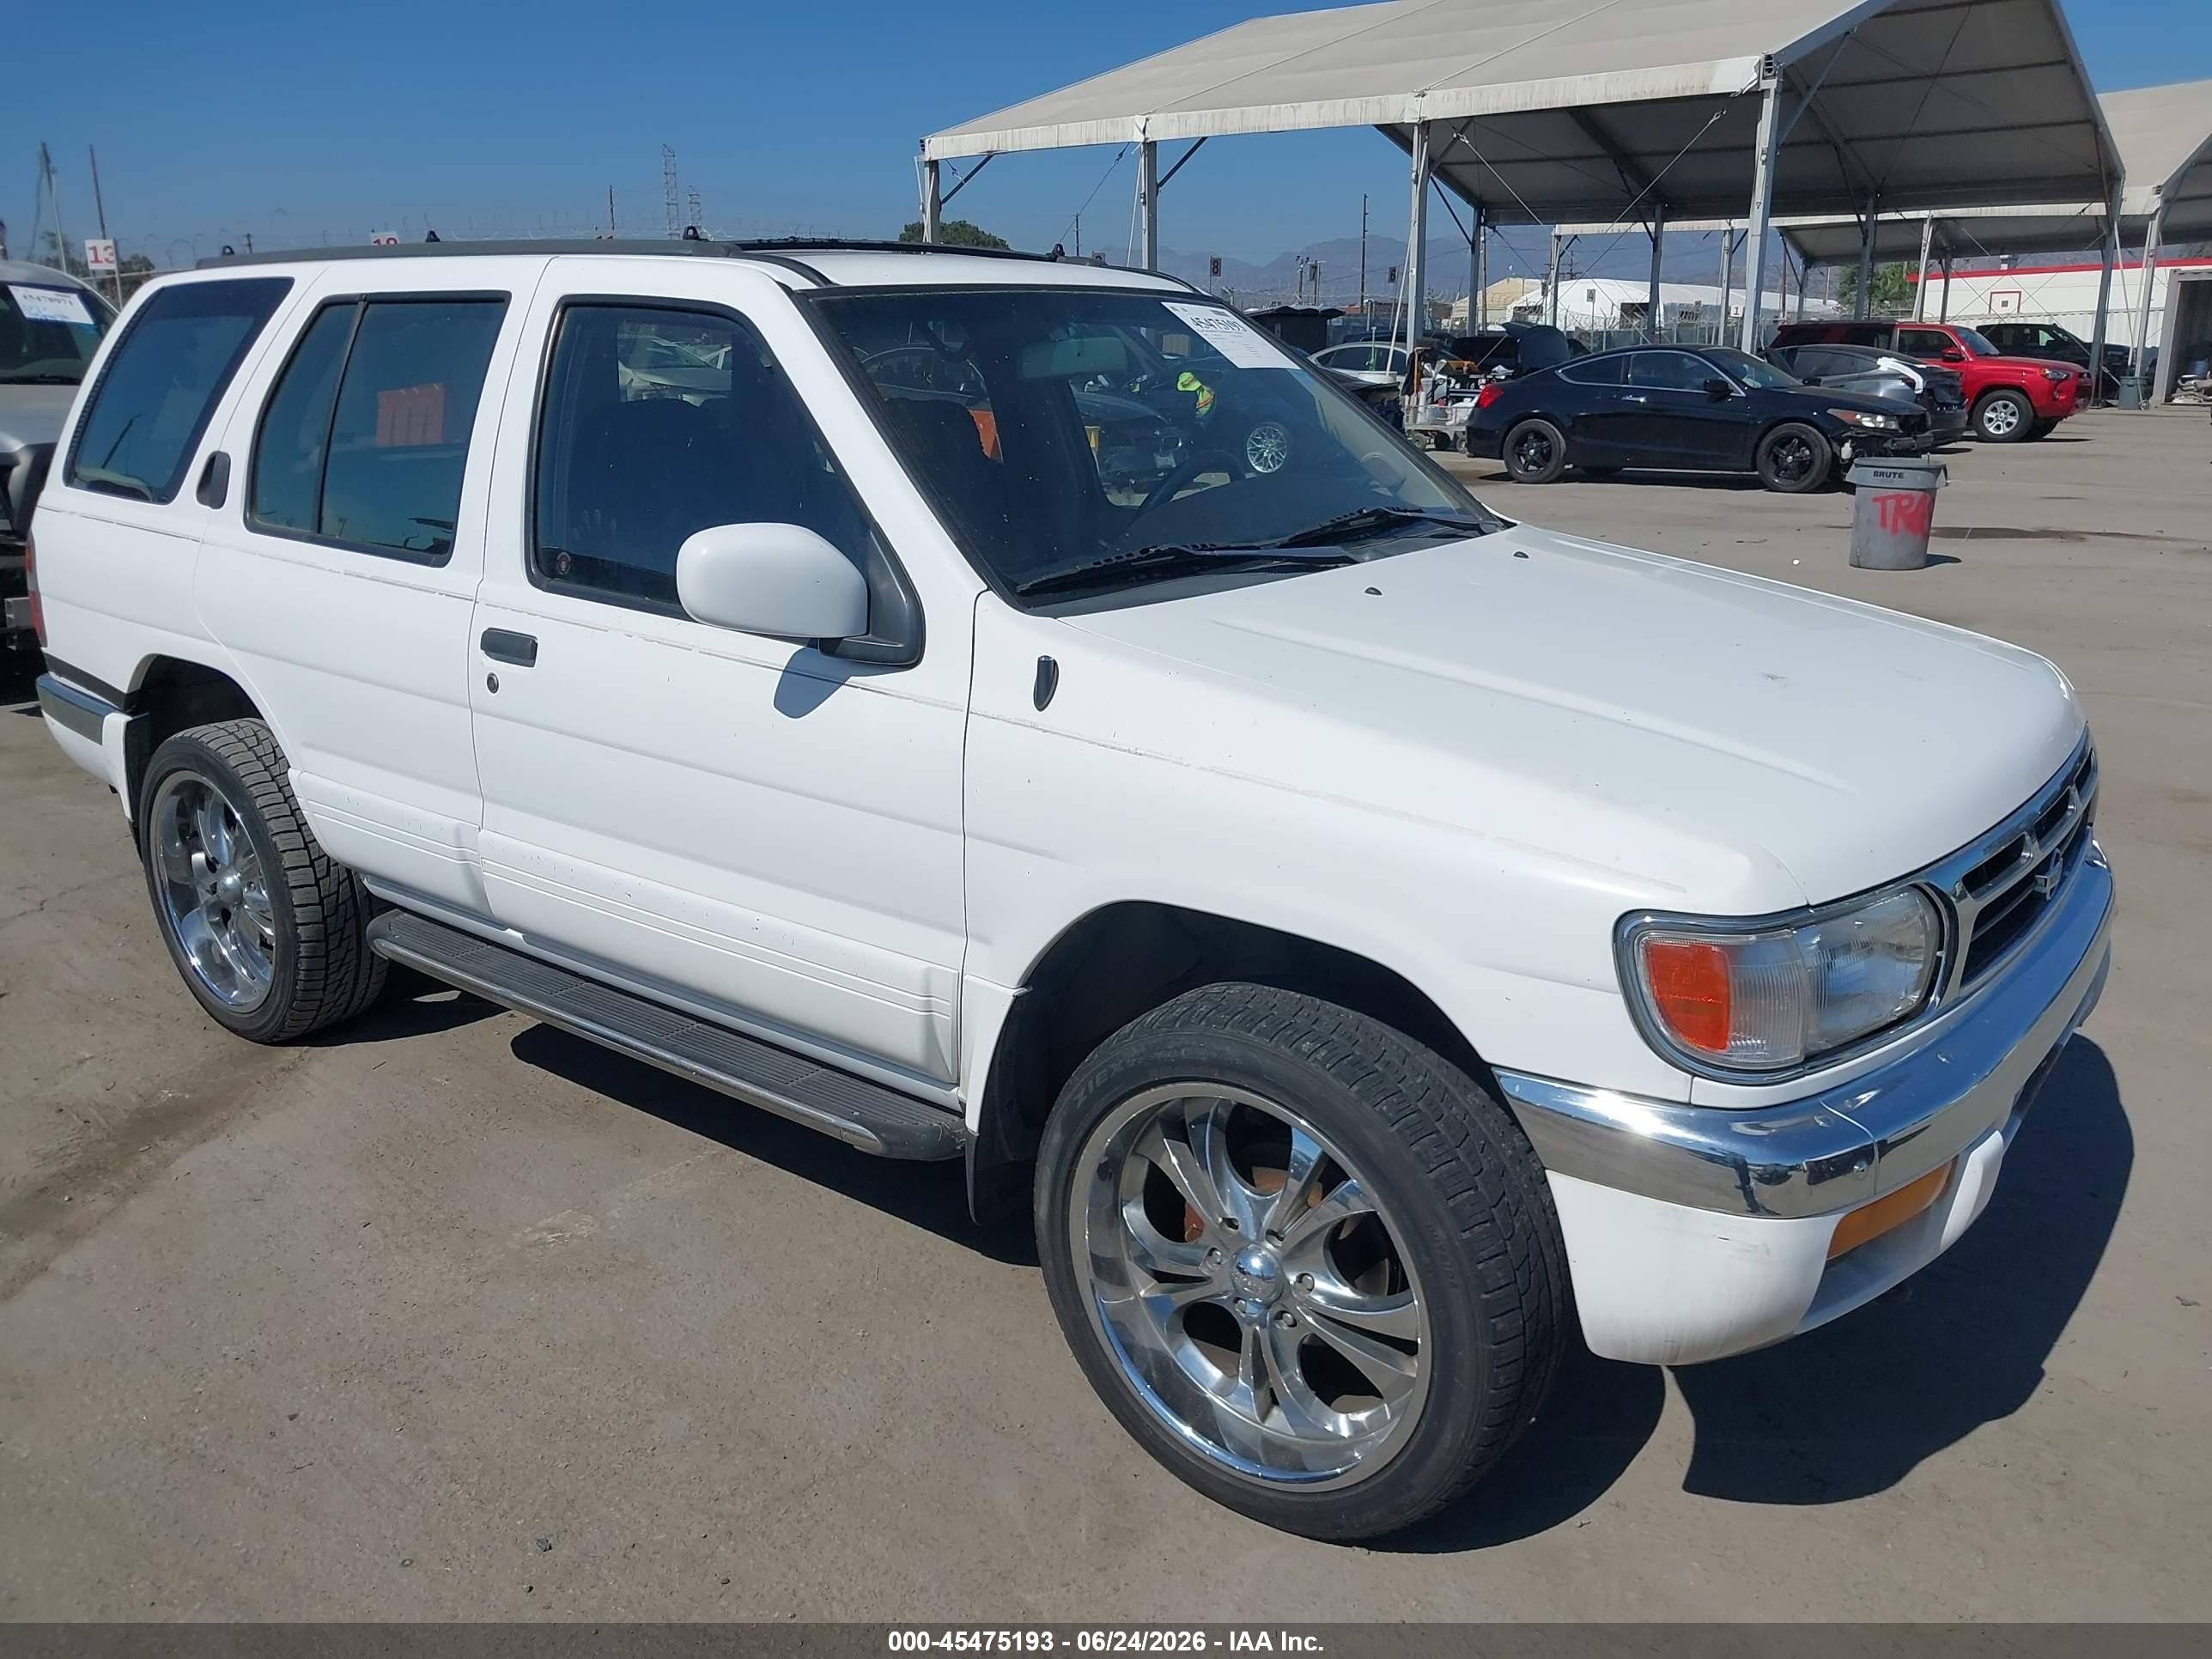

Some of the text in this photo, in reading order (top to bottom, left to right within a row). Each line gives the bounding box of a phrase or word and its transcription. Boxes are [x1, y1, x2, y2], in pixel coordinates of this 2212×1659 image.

[88, 246, 115, 264] 13
[1212, 259, 1219, 275] 8
[1733, 307, 1740, 316] 1
[1873, 471, 1905, 479] BRUTE
